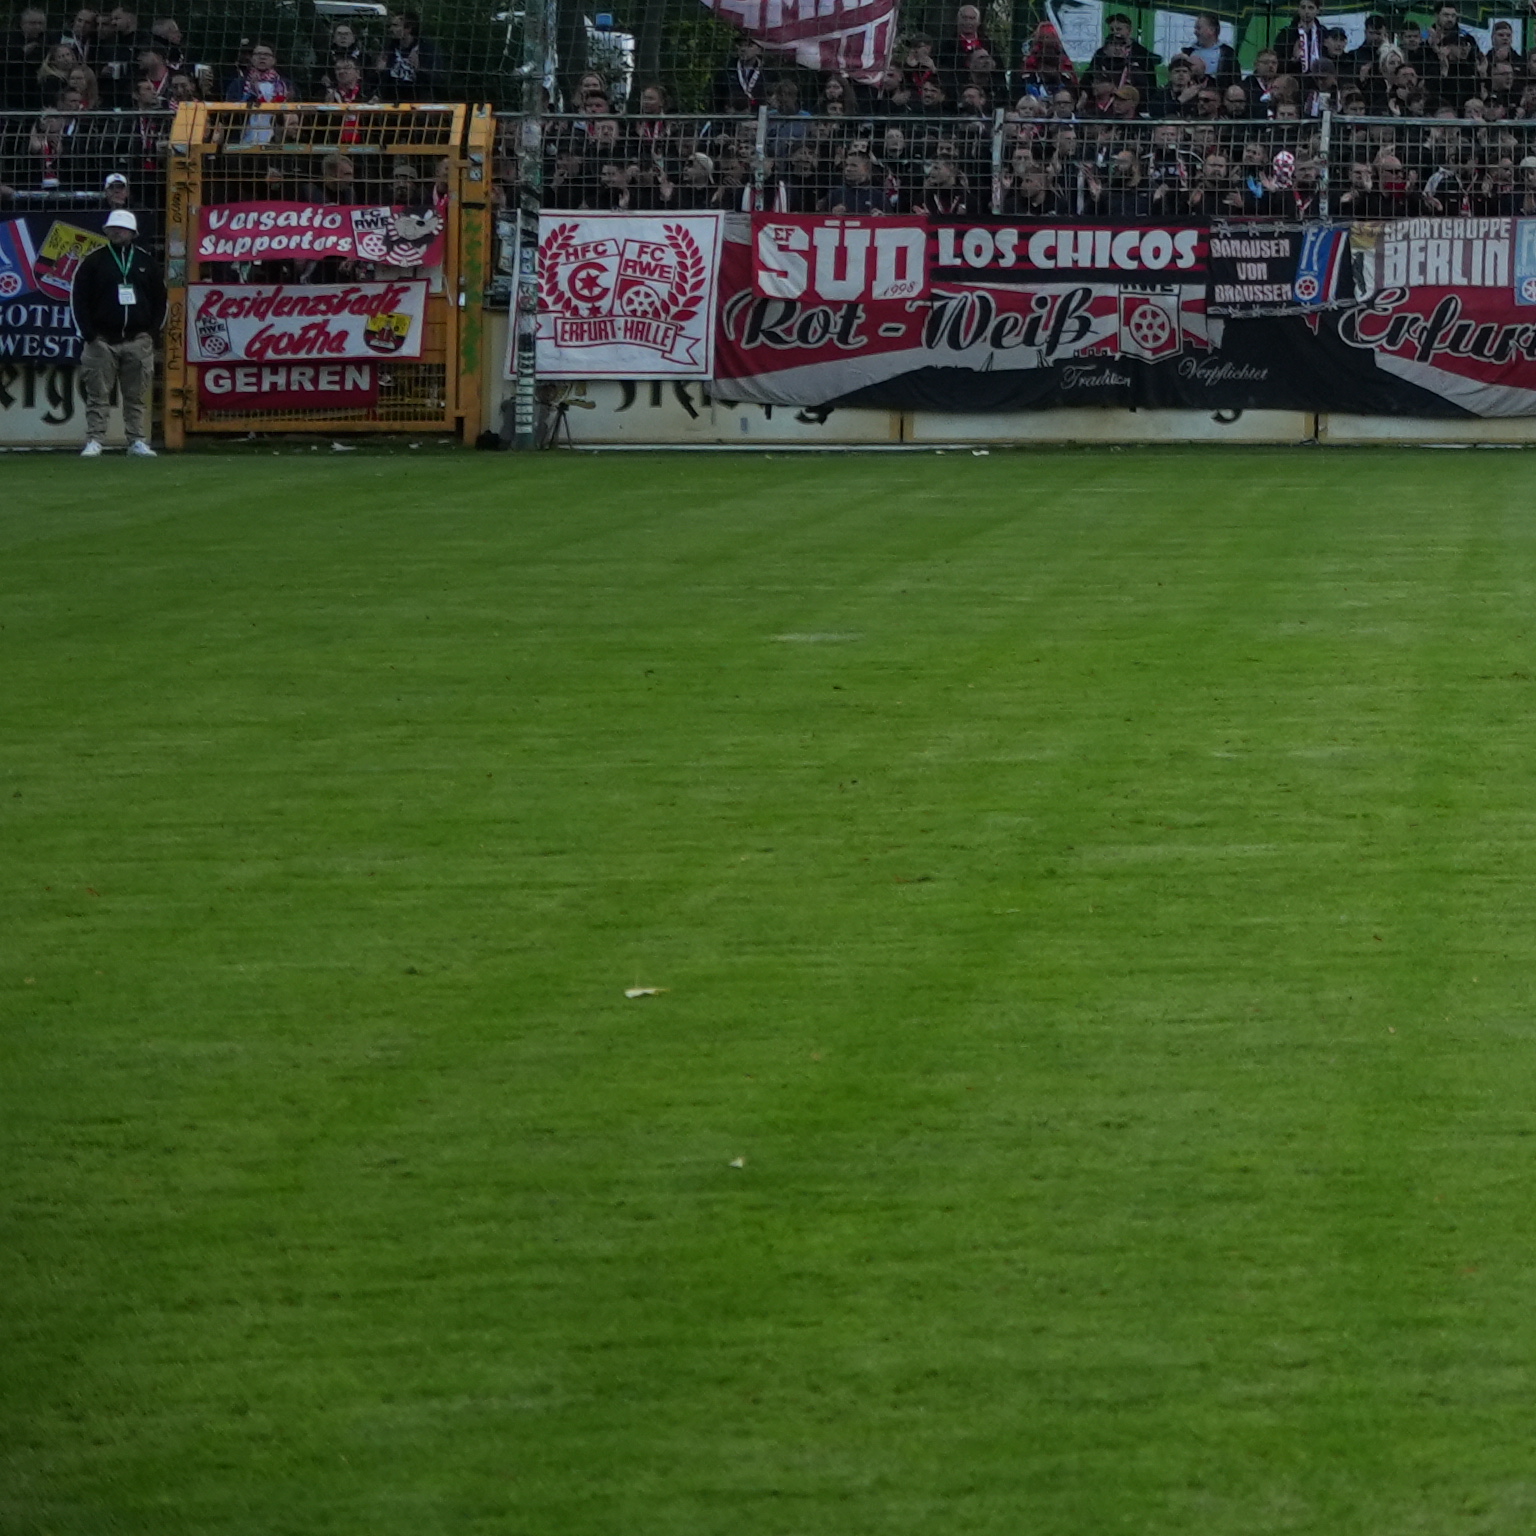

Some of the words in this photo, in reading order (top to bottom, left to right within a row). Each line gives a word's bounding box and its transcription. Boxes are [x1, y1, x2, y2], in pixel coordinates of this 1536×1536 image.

[354, 217, 390, 230] RWE
[1384, 217, 1512, 240] SPORTGRUPPE
[199, 231, 352, 257] Supporters
[565, 242, 608, 263] HFC
[636, 245, 666, 263] FC
[937, 228, 1018, 268] LOS
[1028, 229, 1199, 270] CHICOS
[1210, 238, 1290, 259] BANAUSEN
[622, 259, 674, 280] RWE
[757, 220, 927, 302] SÜD
[1236, 261, 1268, 281] VON
[1383, 239, 1509, 287] BERLIN
[882, 280, 917, 297] 1998
[1214, 283, 1293, 303] DRAUSSEN
[197, 283, 411, 322] Residenzstadt
[560, 319, 618, 343] ERFURT
[623, 319, 674, 347] HALLE
[725, 289, 868, 349] Rot
[906, 286, 1101, 359] Weiß
[244, 319, 349, 362] Gotha
[204, 365, 370, 394] GEHREN
[1061, 364, 1132, 390] Tradition
[1177, 355, 1269, 387] Verpflichtet
